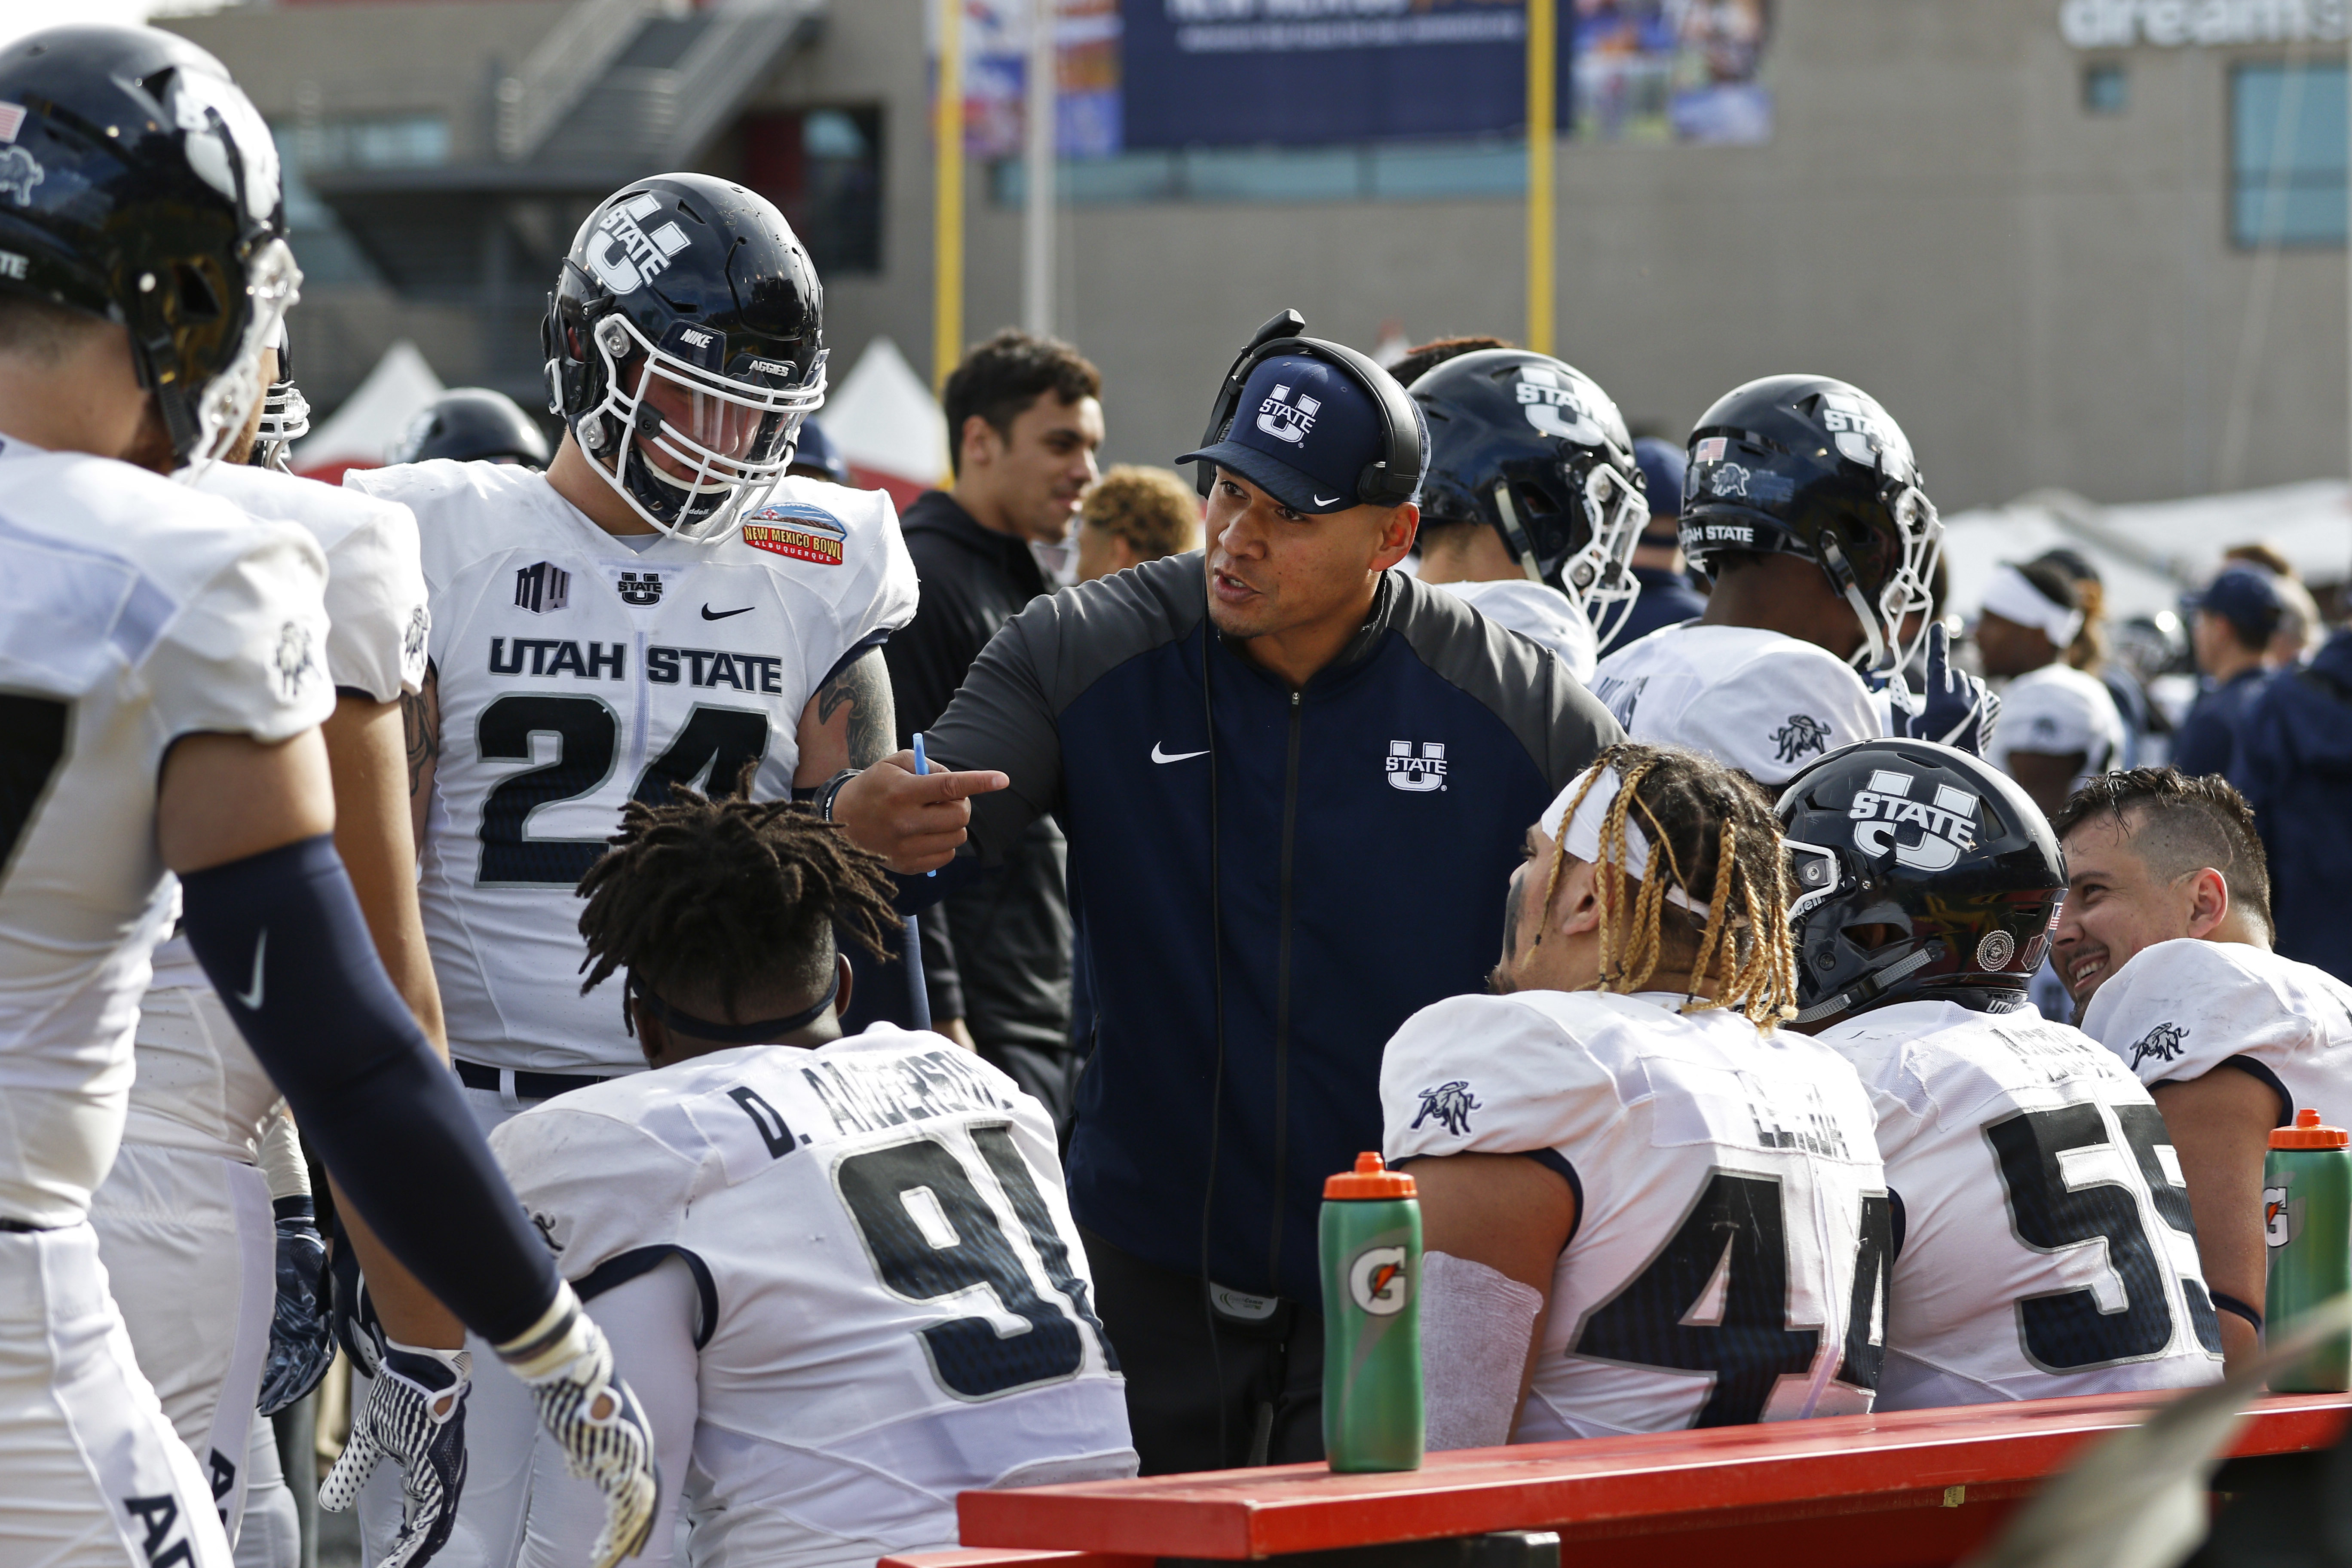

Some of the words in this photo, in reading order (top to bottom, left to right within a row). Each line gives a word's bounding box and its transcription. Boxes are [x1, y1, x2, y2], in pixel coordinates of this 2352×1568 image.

[599, 205, 671, 285] STATE
[0, 251, 29, 280] TE
[680, 328, 714, 349] NIKE
[749, 360, 790, 377] AGGIES
[1259, 398, 1316, 434] STATE
[679, 505, 709, 515] ddell
[744, 526, 768, 541] NEW
[771, 529, 810, 548] MEXICO
[813, 537, 842, 560] BOWL
[1706, 525, 1754, 542] STATE
[755, 541, 831, 562] ALBUQUERQUE
[618, 581, 662, 593] STATE
[487, 635, 627, 681] UTAH
[646, 644, 783, 697] STATE
[1385, 756, 1447, 775] STATE
[1849, 792, 1977, 851] STATE
[727, 1087, 812, 1159] D.
[831, 1119, 1127, 1403] 91
[1348, 1245, 1406, 1317] G
